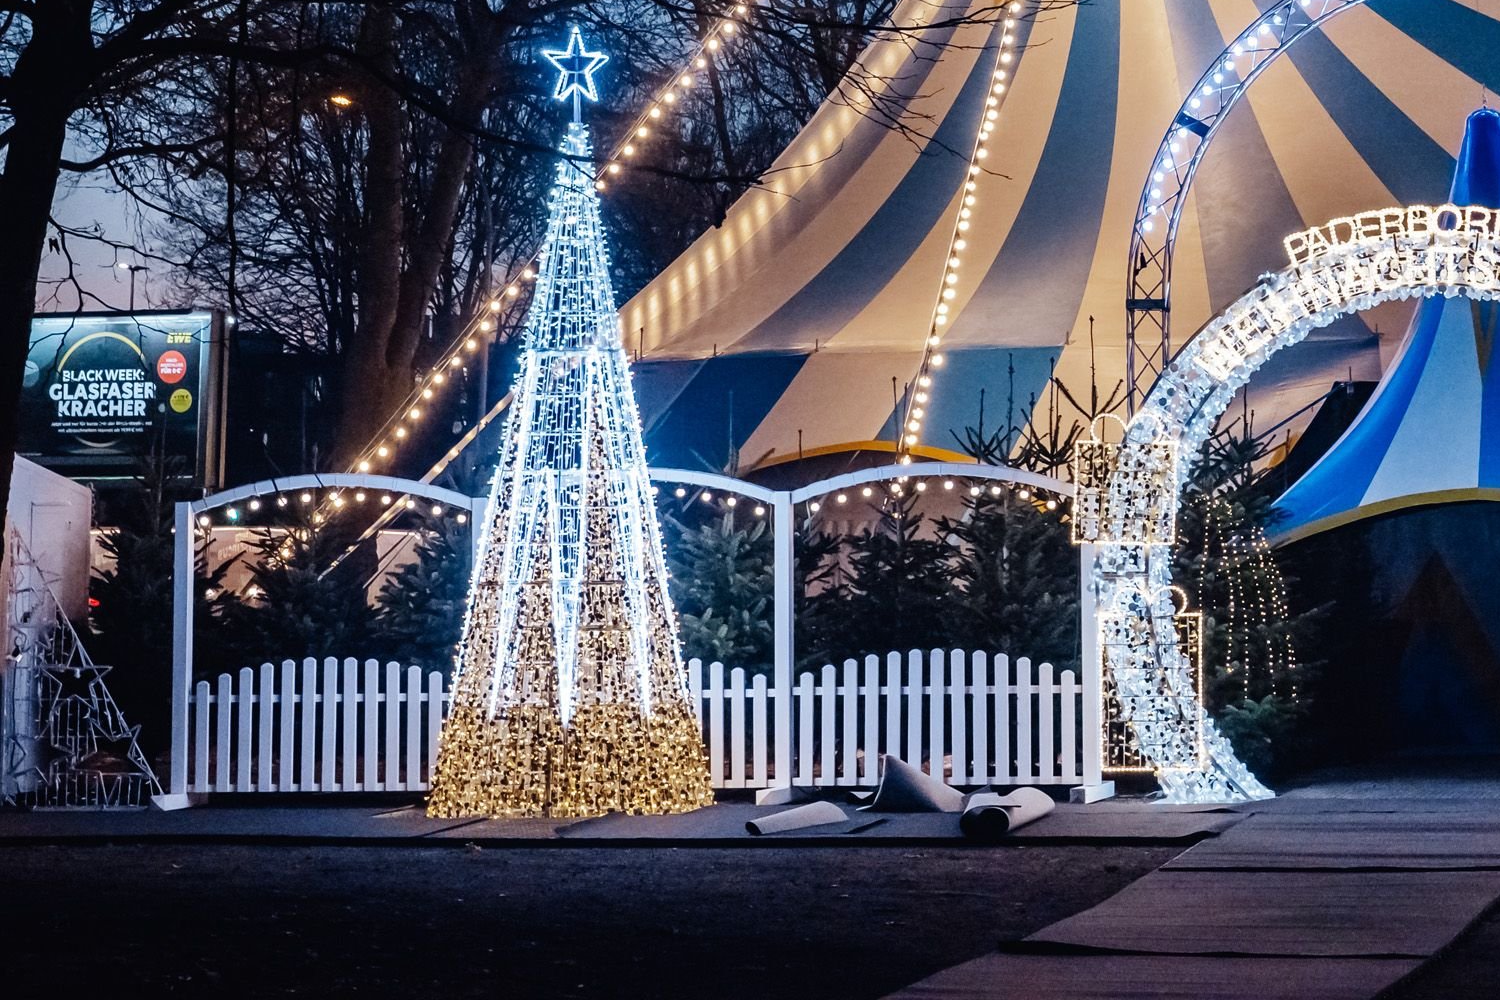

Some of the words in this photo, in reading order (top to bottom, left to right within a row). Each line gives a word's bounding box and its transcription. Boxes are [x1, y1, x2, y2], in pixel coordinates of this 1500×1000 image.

[62, 369, 103, 382] BLACK
[104, 368, 145, 381] WEEK:
[49, 382, 157, 400] GLASFASER
[58, 400, 147, 417] KRACHER
